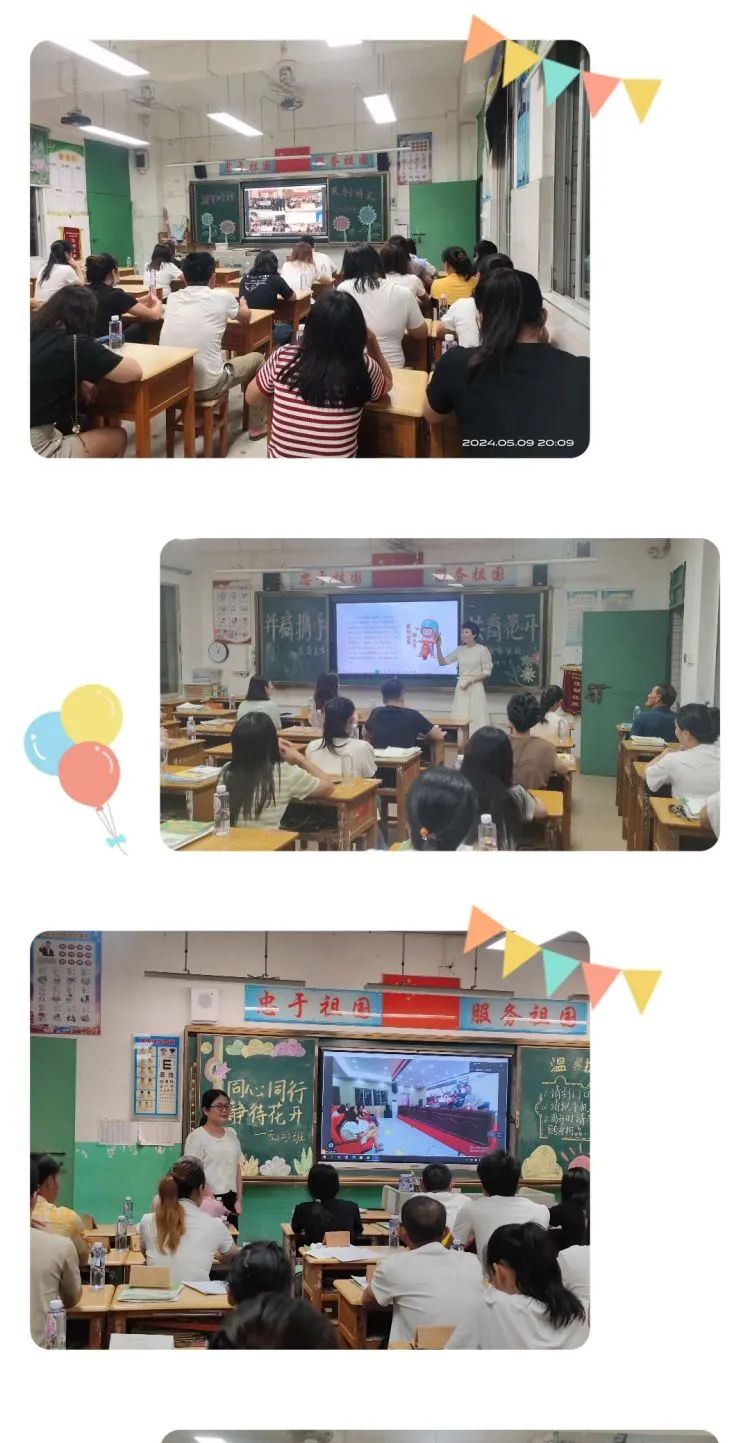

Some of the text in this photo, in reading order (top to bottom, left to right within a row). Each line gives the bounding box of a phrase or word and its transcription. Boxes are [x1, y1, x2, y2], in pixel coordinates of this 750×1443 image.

[257, 991, 371, 1019] 忠于祖国
[471, 1003, 577, 1028] 服务祖国
[227, 1079, 308, 1104] 同心同行
[228, 1102, 303, 1127] 静待花开
